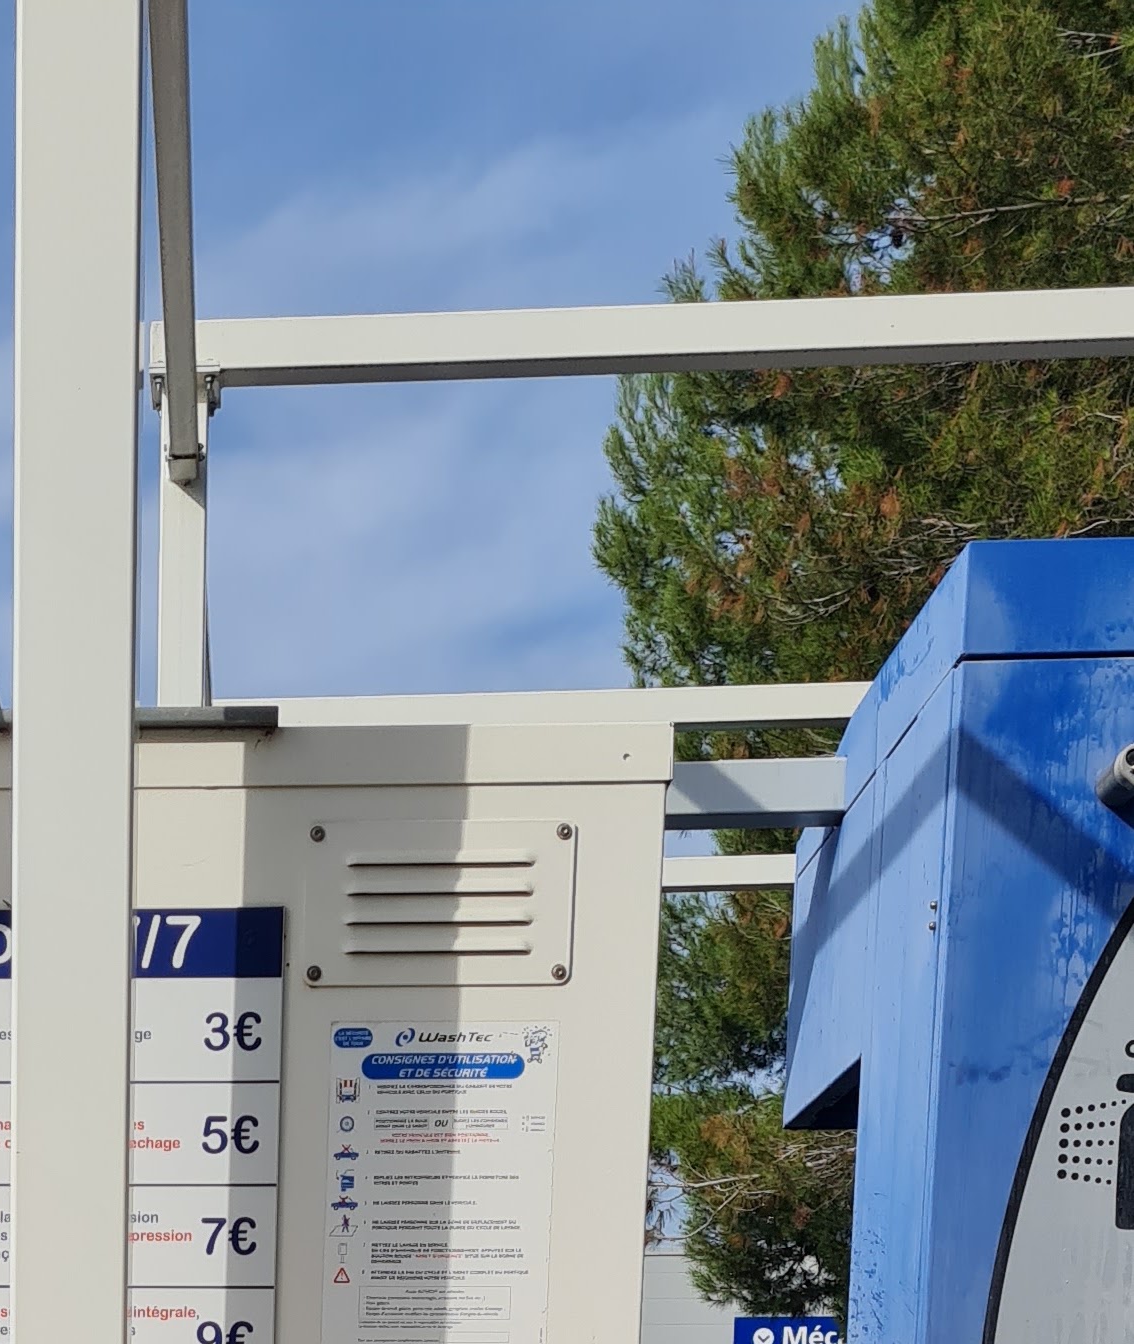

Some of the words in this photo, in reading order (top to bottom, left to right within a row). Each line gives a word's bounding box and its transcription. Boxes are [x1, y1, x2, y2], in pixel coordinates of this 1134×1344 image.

[132, 914, 202, 969] /7
[203, 1011, 263, 1052] 3€
[418, 1032, 494, 1043] WashTec
[370, 1054, 436, 1065] CONSIGNES
[398, 1068, 414, 1078] ET
[415, 1068, 432, 1078] DE
[432, 1066, 490, 1078] SÉCURITÉ
[201, 1115, 260, 1155] 5€
[200, 1216, 258, 1256] 7€
[133, 1305, 200, 1321] intégrale,
